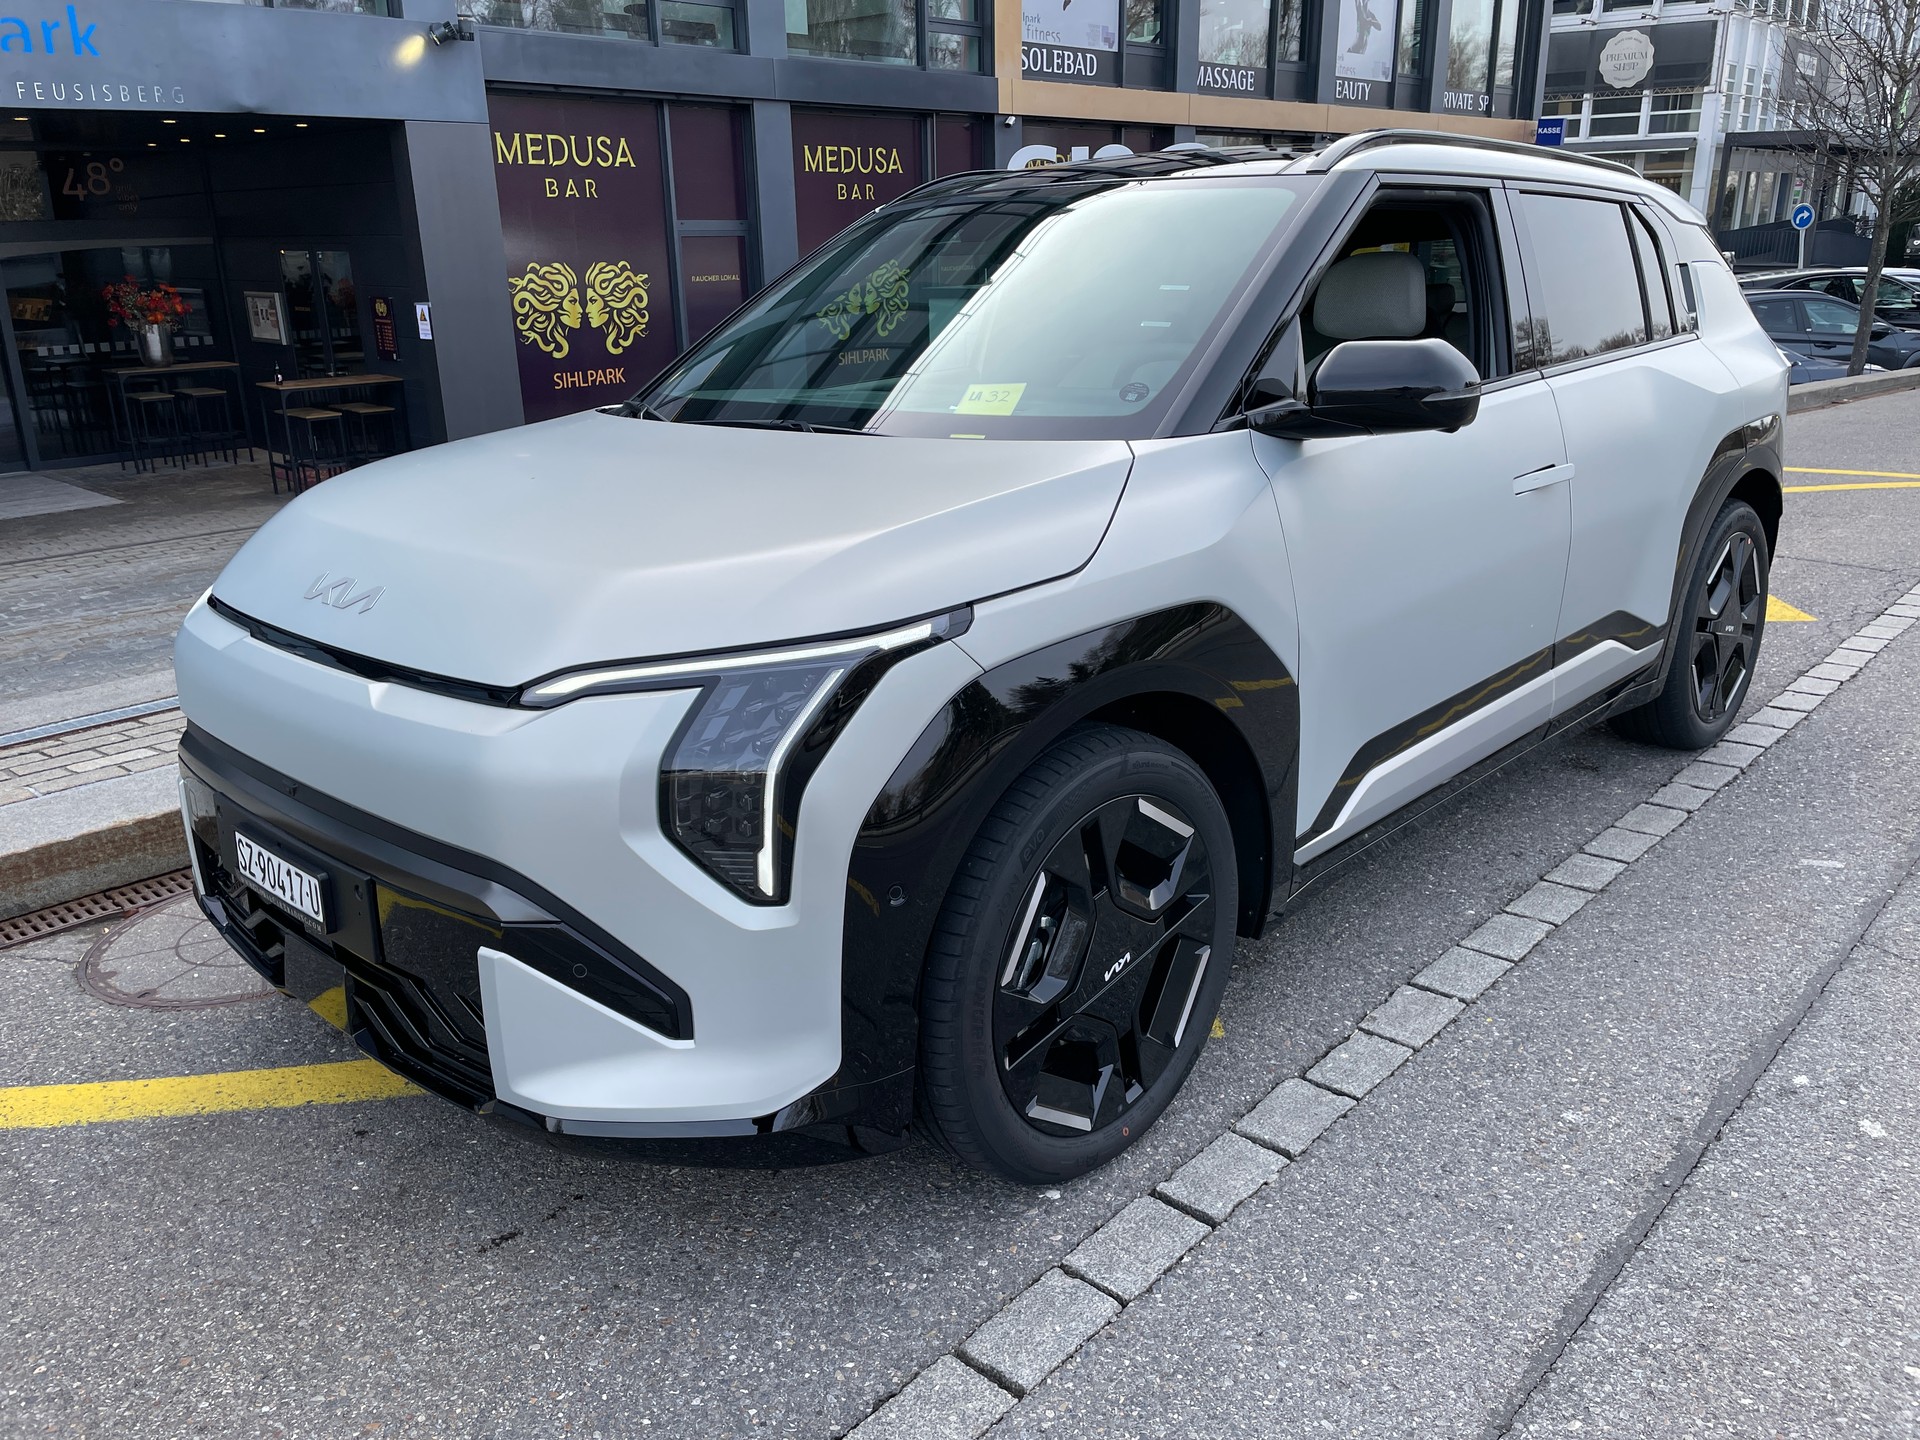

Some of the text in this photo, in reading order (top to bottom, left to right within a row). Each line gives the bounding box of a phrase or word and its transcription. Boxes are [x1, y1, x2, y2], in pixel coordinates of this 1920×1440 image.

[0, 5, 100, 57] ark
[1026, 25, 1061, 43] fitness
[1021, 47, 1098, 77] SOLEBAD
[1606, 51, 1648, 62] PREMIUM
[1613, 62, 1639, 72] SHOP
[16, 82, 185, 105] FEUSISBERG
[1538, 127, 1561, 135] KASSE
[495, 131, 636, 169] MEDUSA
[803, 145, 904, 175] MEDUSA
[545, 178, 598, 199] BAR
[837, 183, 875, 201] BAR
[838, 347, 890, 366] SIHLPARK
[553, 367, 626, 390] SIHLPARK
[984, 390, 1010, 402] 32
